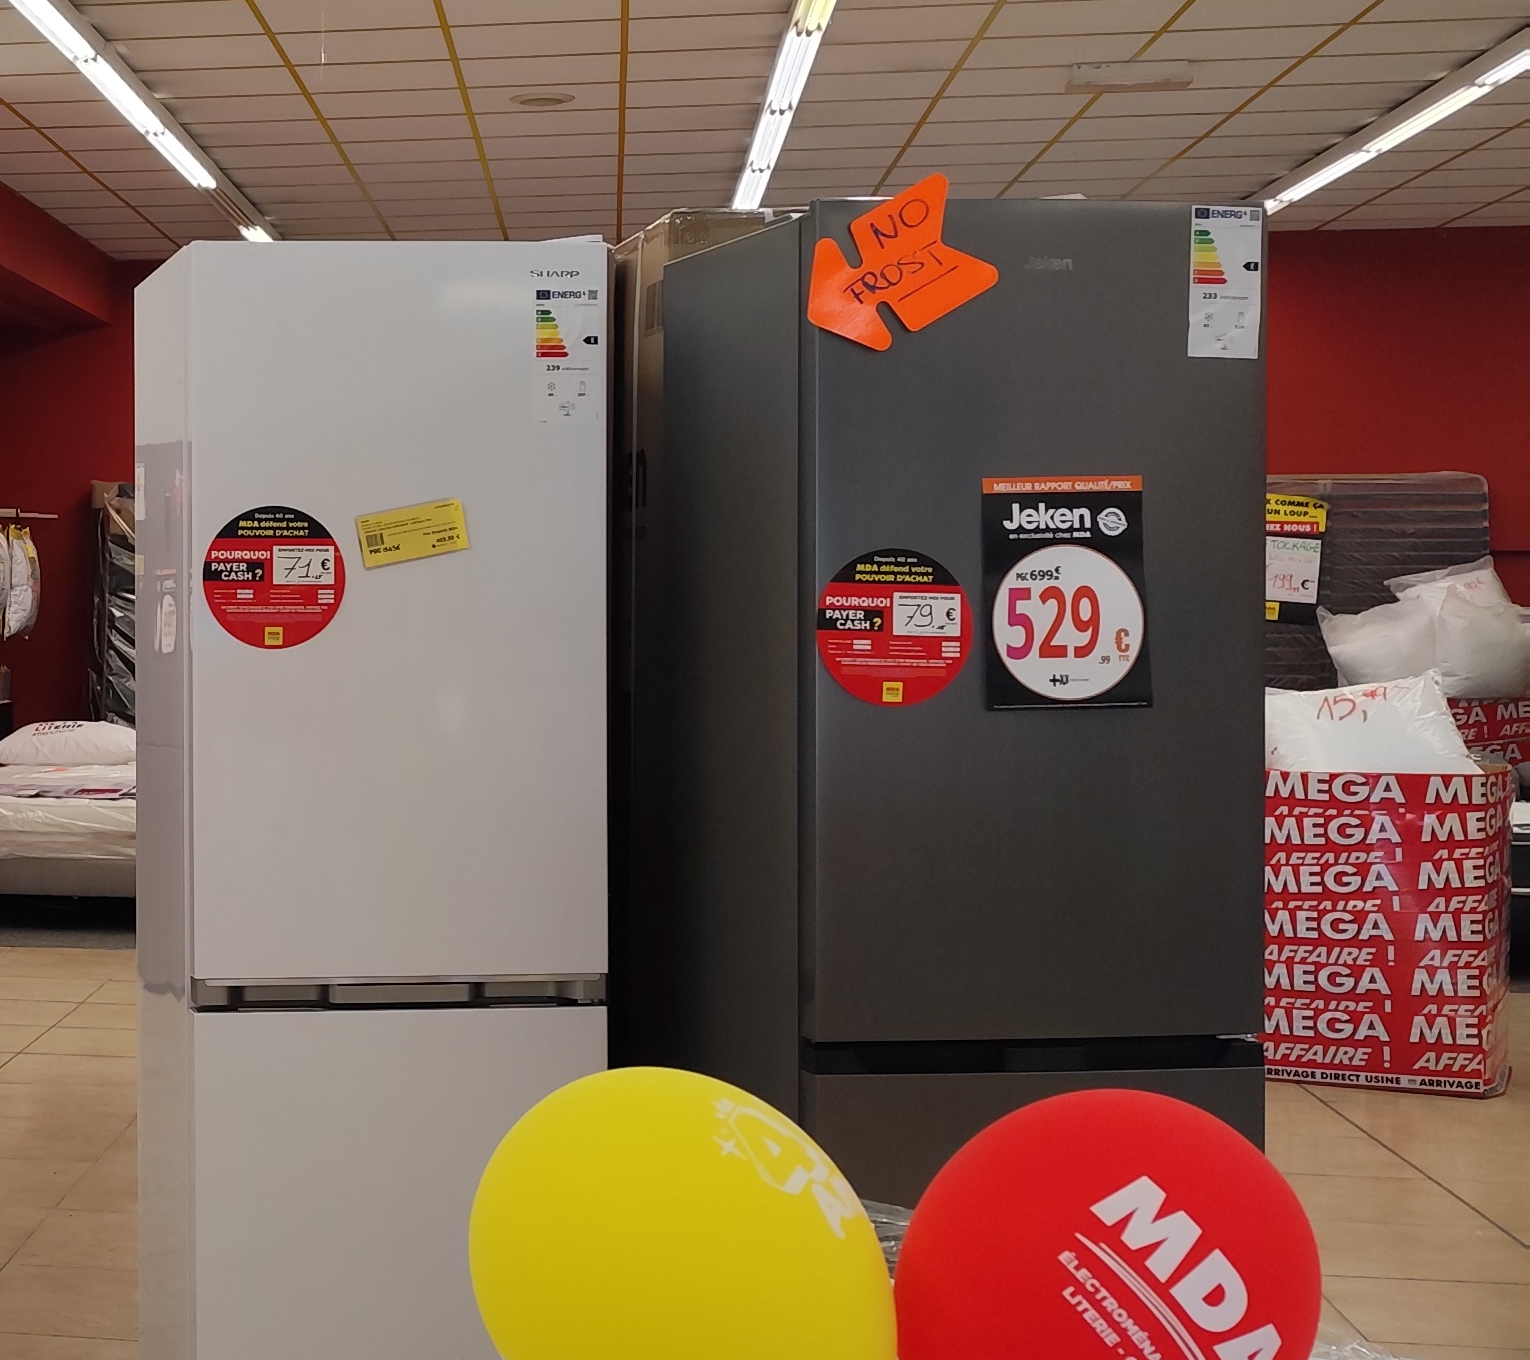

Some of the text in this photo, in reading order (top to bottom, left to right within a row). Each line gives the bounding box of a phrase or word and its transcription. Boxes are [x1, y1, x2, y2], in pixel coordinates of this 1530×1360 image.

[870, 198, 930, 250] NO
[529, 269, 580, 279] SHARP
[842, 239, 944, 305] FROST
[551, 290, 582, 299] ENERG
[993, 481, 1032, 492] MEILLEUR
[1034, 480, 1074, 491] RAPPORT
[1275, 499, 1310, 508] COMME
[1002, 502, 1092, 530] Jeken
[238, 520, 258, 528] MDA
[259, 520, 287, 528] défend
[1284, 524, 1312, 532] NOUS
[237, 529, 309, 537] POUVOIR D'ACHAT
[1270, 540, 1321, 553] TOCKAGE
[210, 550, 271, 561] POURQUOI
[211, 562, 248, 572] PAYER
[321, 557, 331, 571] €
[856, 564, 878, 572] MDA
[880, 564, 909, 572] défend
[221, 571, 253, 581] CASH
[896, 574, 934, 582] D'ACHAT
[1029, 569, 1054, 581] 699
[826, 596, 891, 607] POURQUOI
[826, 610, 865, 619] PAYER
[946, 607, 956, 621] €
[837, 621, 870, 629] CASH
[1006, 585, 1101, 660] 529
[1115, 628, 1131, 654] €
[1497, 703, 1530, 722] ME
[1265, 770, 1503, 805] MEGA MEGA
[1265, 816, 1402, 845] MEGA
[1264, 864, 1399, 893] MEGA
[1264, 909, 1395, 940] MEGA
[1264, 945, 1377, 965] AFFAIRE
[1419, 949, 1488, 967] AFFA
[1264, 963, 1392, 995] MEGA
[1264, 1008, 1390, 1042] MEGA
[1263, 1041, 1372, 1066] AFFAIRE
[1413, 1051, 1484, 1072] AFFA
[1266, 1067, 1481, 1091] RRIVAGE DIRECT USINE ARRIVAGE
[1061, 1286, 1121, 1348] LITERIE
